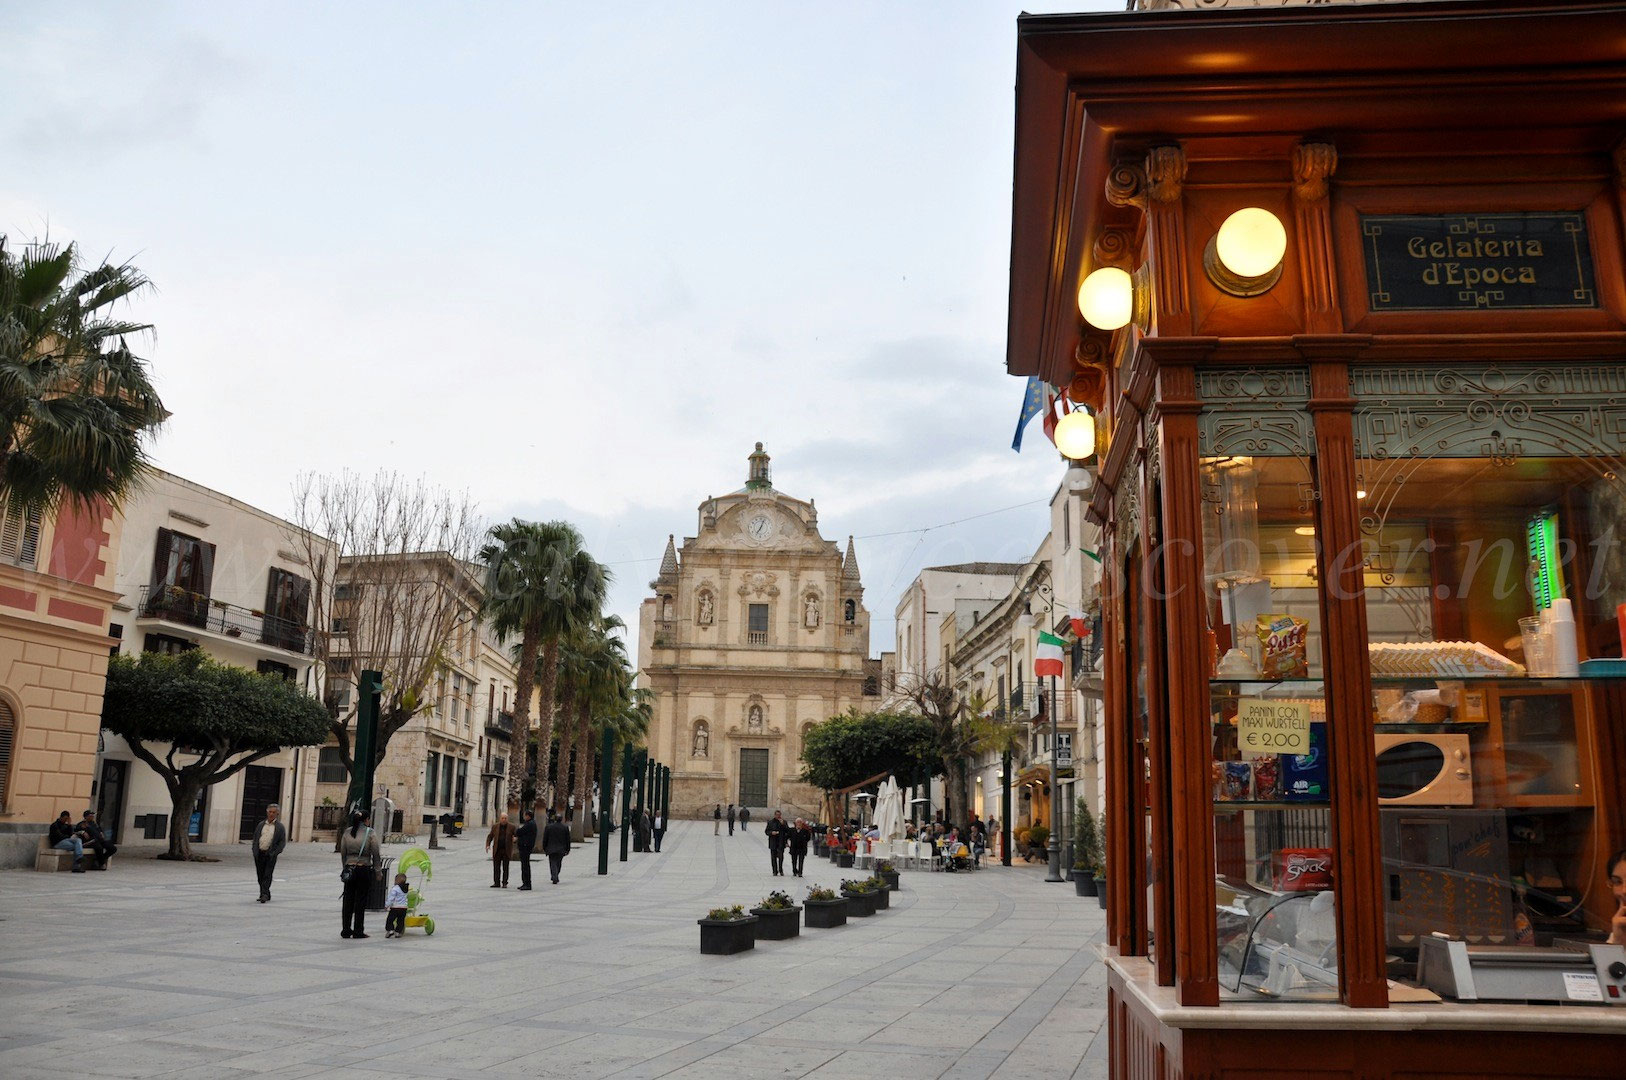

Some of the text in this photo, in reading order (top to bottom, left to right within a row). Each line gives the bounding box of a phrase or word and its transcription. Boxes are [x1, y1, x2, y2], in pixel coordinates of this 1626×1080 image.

[1407, 235, 1544, 259] Gelateria
[1422, 262, 1537, 289] d'Epoca
[1249, 706, 1299, 719] PANINI CON
[1242, 717, 1306, 730] MAXI WURSTELL
[1246, 732, 1301, 748] € 2,00
[1293, 780, 1308, 790] AIR
[1287, 860, 1327, 881] SNACK
